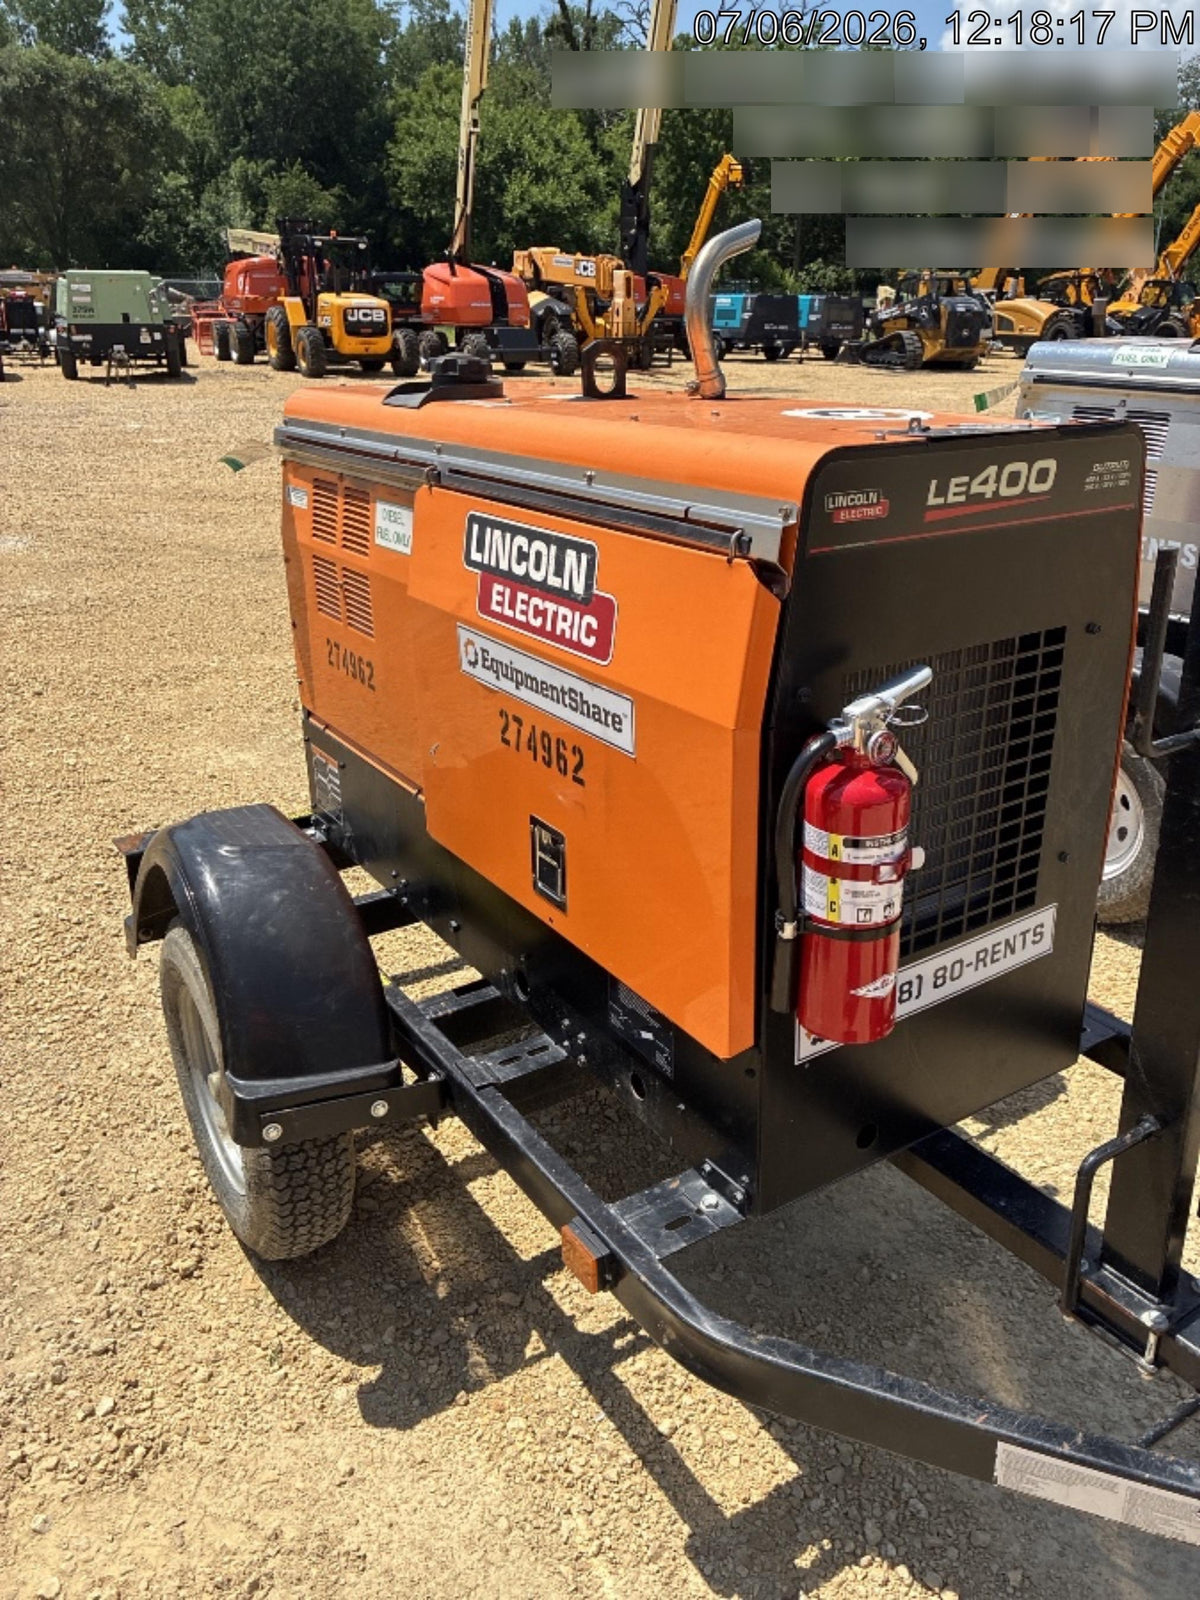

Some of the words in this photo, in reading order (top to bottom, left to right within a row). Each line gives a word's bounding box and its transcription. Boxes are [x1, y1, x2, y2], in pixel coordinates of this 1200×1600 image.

[346, 309, 385, 322] JCB
[828, 491, 878, 509] LINCOLN
[925, 458, 1058, 507] LE400
[840, 506, 883, 520] ELECTRIC
[469, 523, 588, 595] LINCOLN
[490, 584, 599, 648] ELECTRIC
[326, 637, 377, 692] 274962
[480, 647, 625, 734] EquipmentShare
[499, 708, 587, 787] 274962
[831, 844, 839, 858] A
[829, 900, 837, 913] C
[932, 922, 1045, 991] 80-RENTS
